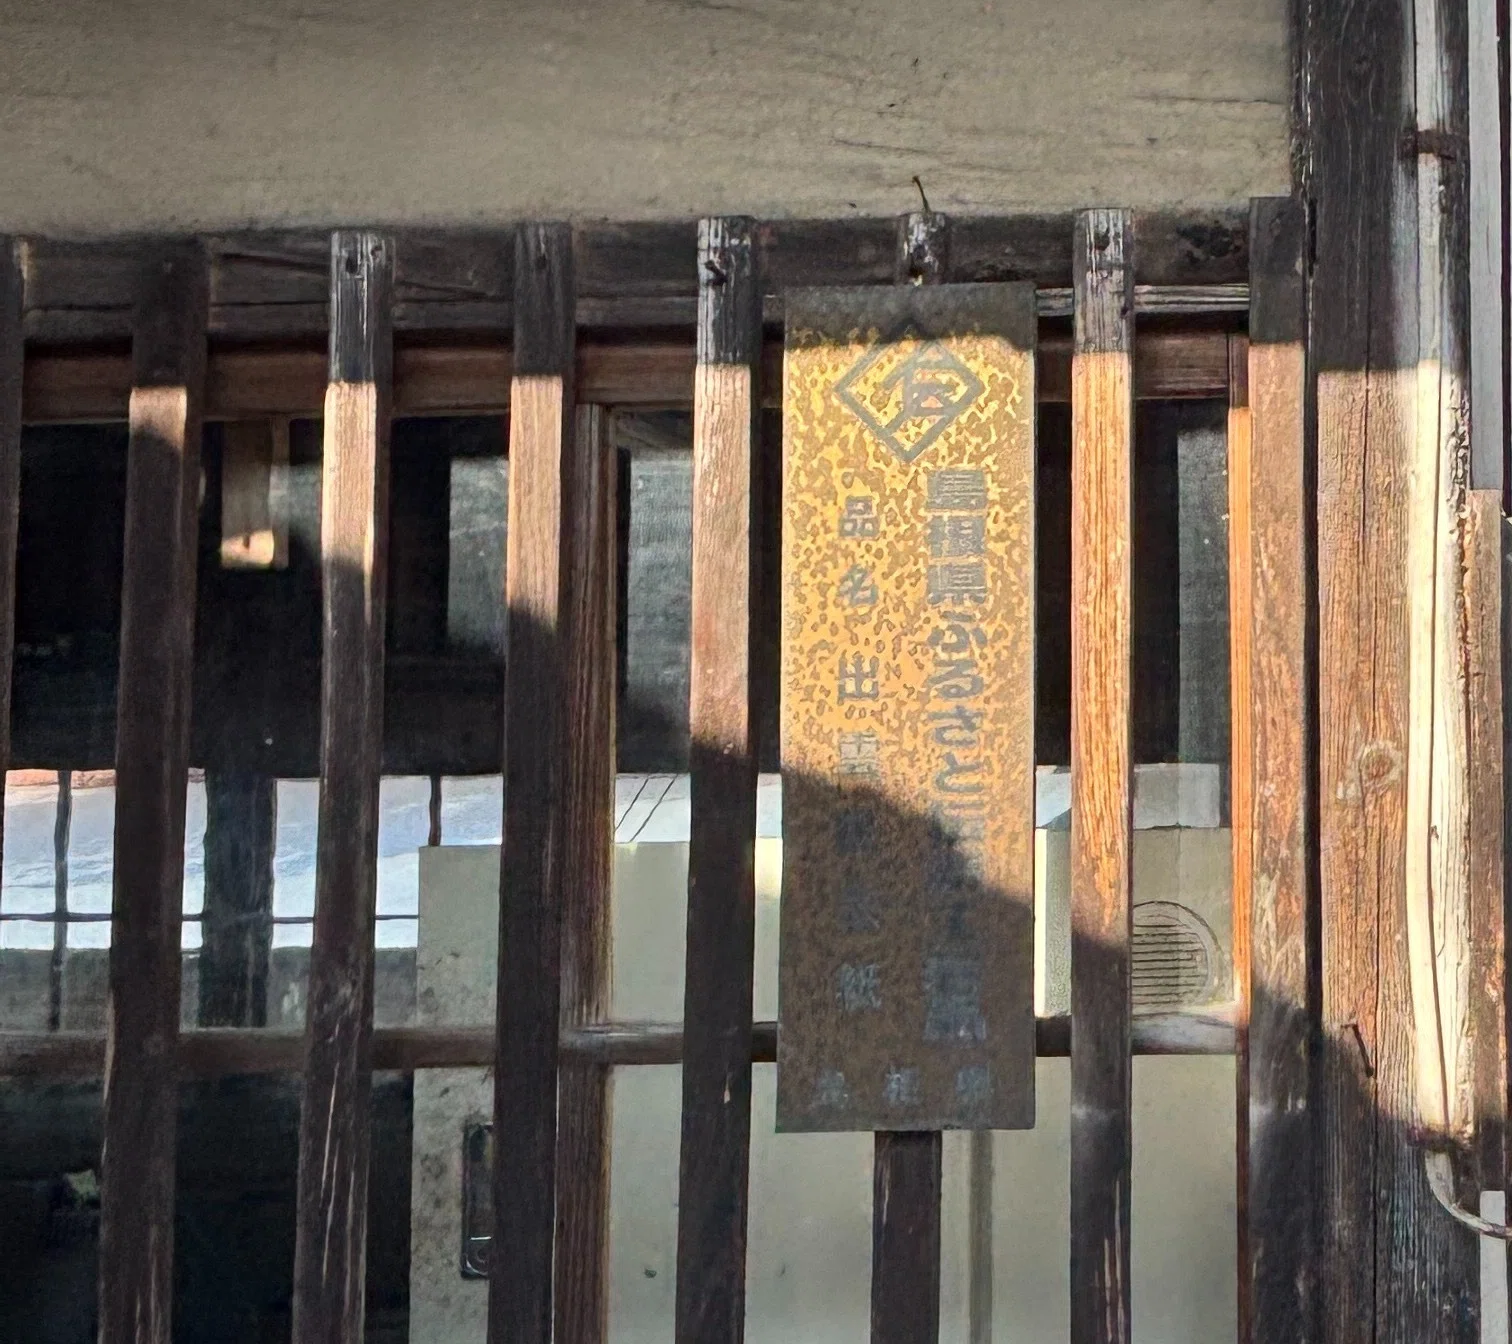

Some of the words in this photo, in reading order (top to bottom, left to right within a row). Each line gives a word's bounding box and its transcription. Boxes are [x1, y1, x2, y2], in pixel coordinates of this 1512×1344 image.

[921, 469, 989, 1046] 島根県ふるさと
